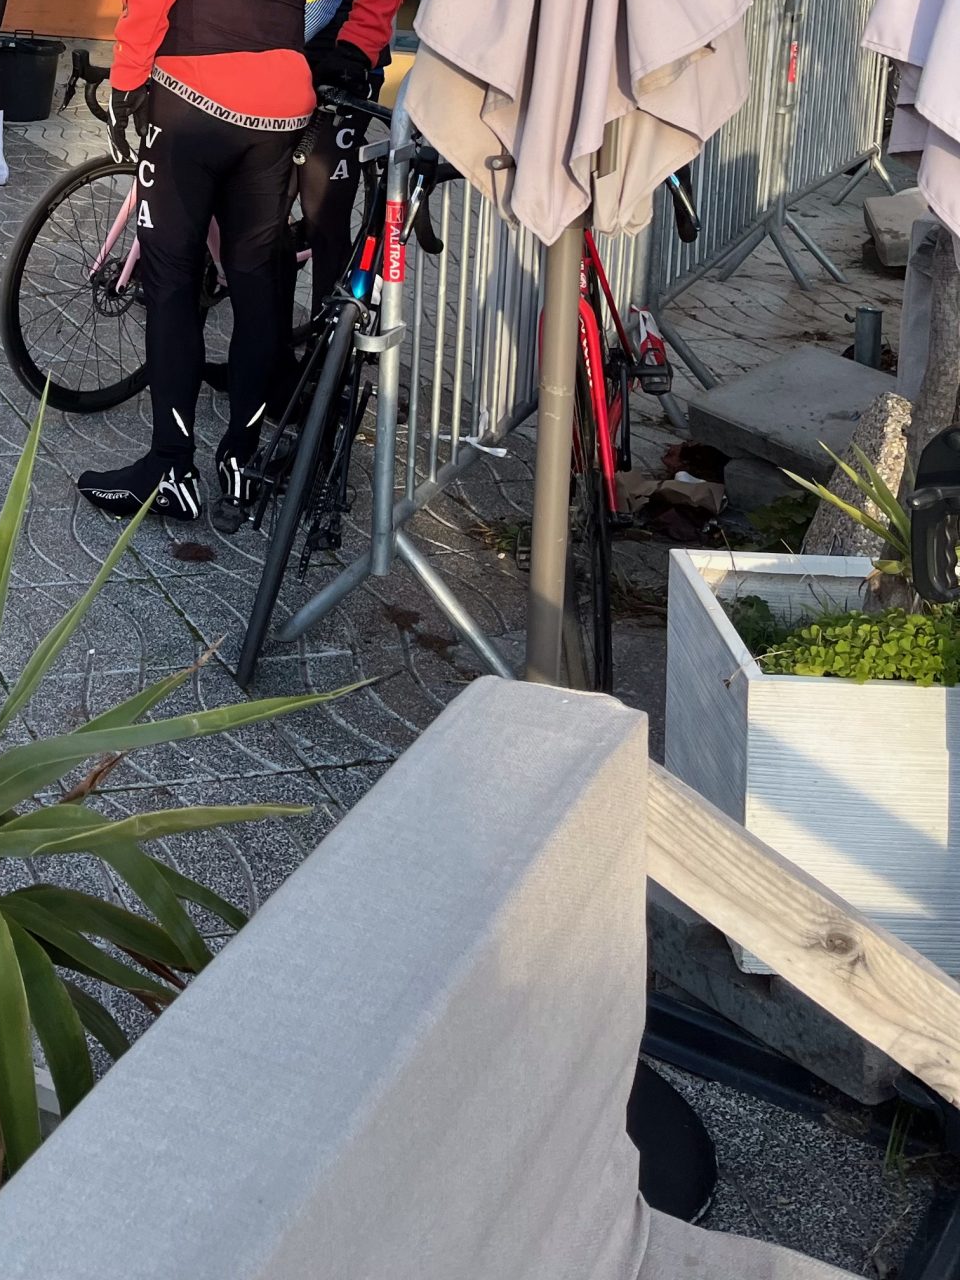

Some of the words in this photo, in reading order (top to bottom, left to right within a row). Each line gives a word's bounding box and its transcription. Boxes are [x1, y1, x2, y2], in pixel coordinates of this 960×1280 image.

[137, 123, 161, 228] VCA
[330, 127, 356, 179] CA
[390, 225, 400, 280] ALTRAD
